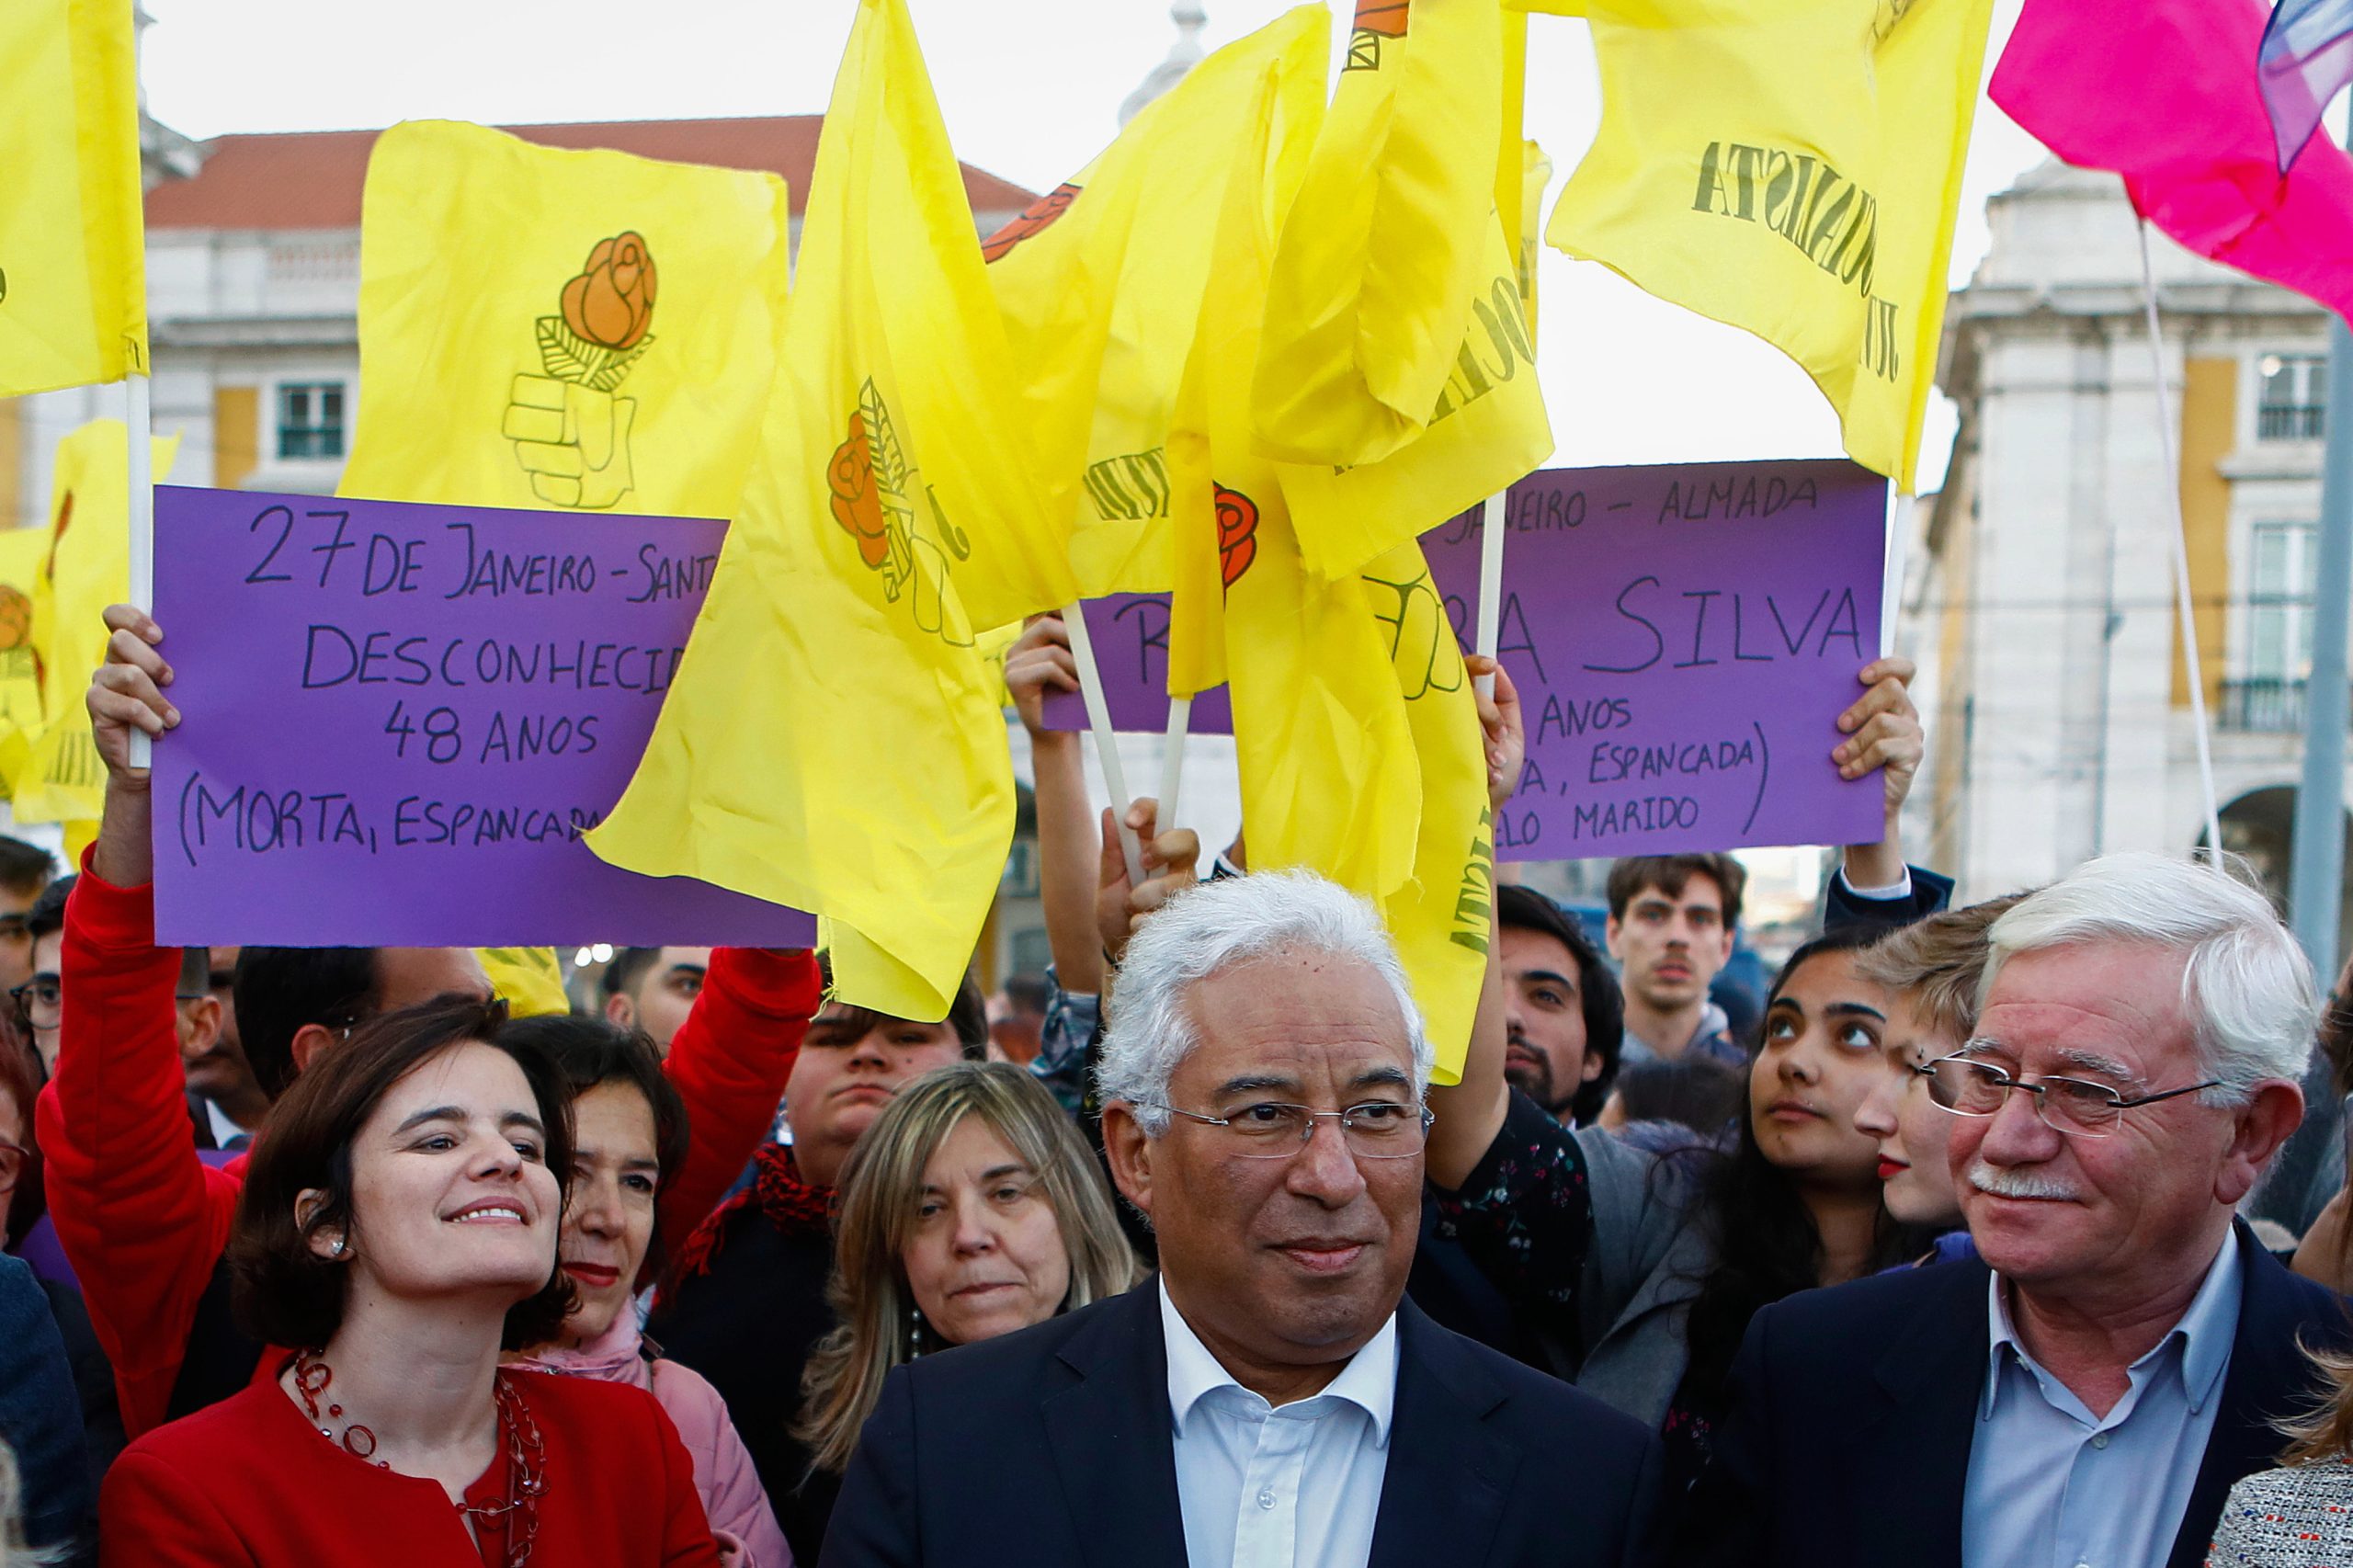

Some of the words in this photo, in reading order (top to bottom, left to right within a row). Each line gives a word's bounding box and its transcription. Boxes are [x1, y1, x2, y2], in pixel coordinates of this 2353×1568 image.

[1658, 476, 1818, 525] ALMADA
[244, 505, 356, 588] 27
[362, 534, 426, 597] DE
[444, 523, 596, 599] JANEIRO
[625, 543, 715, 602] SANT
[1583, 575, 1862, 674] SILVA
[384, 699, 461, 764] 48
[480, 710, 599, 765] ANOS
[1537, 694, 1632, 746] ANOS
